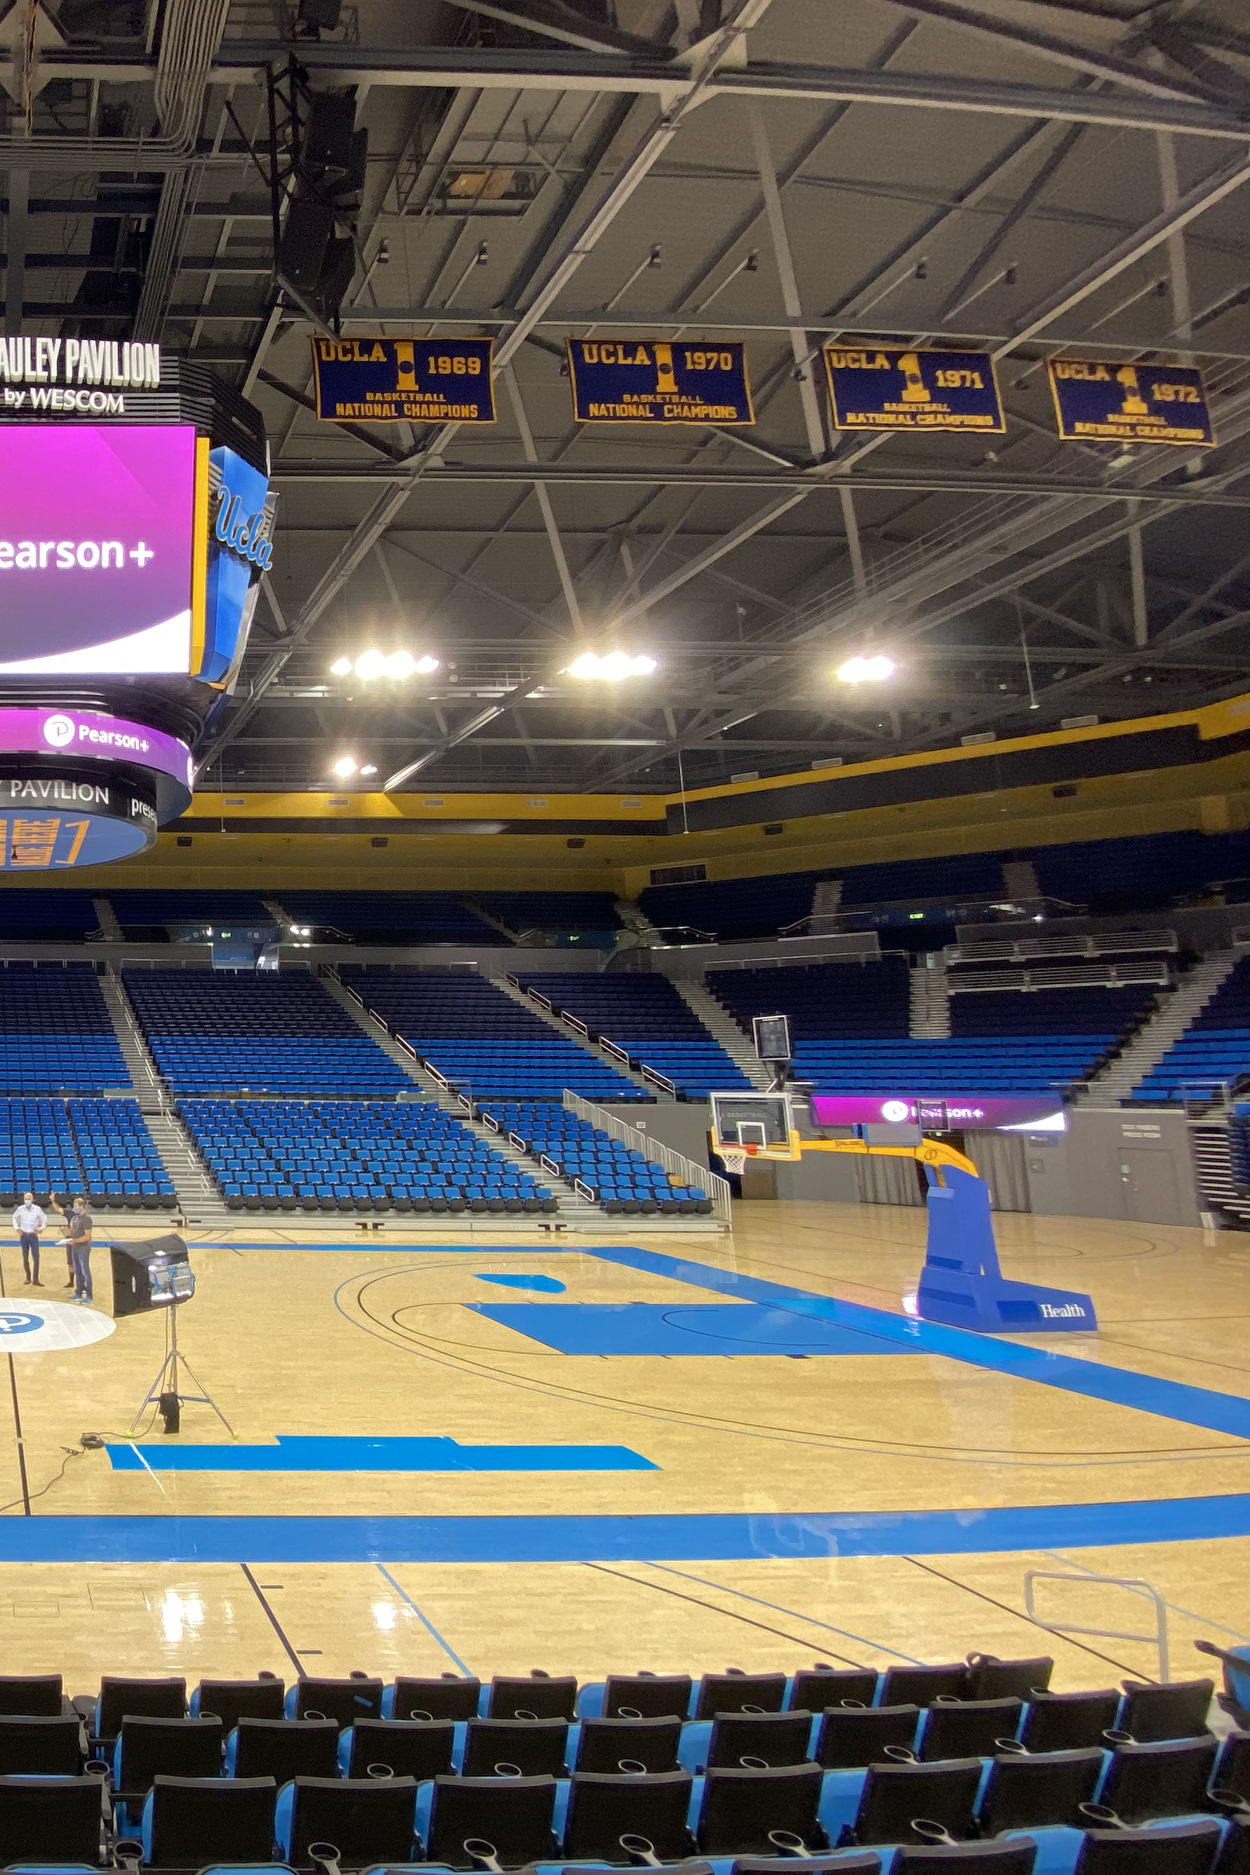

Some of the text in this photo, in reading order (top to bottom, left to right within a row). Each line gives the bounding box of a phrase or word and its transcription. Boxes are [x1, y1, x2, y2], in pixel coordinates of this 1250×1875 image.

[65, 339, 160, 388] PAVILION
[320, 342, 387, 362] UCLA
[428, 356, 481, 375] 1969
[582, 344, 651, 365] UCLA
[685, 352, 733, 371] 1970
[831, 352, 891, 370] UCLA
[935, 370, 984, 389] 1971
[1055, 363, 1110, 381] UCLA
[1151, 384, 1200, 403] 1972
[4, 387, 26, 405] by
[30, 388, 125, 413] WESCOM
[366, 392, 446, 402] BASKETBALL
[622, 394, 703, 404] BASKETBALL
[883, 402, 951, 412] BASKETBALL
[335, 403, 478, 418] NATIONAL CHAMPIONS
[588, 404, 737, 419] NATIONAL CHAMPIONS
[846, 412, 994, 426] NATIONAL CHAMPIONS
[78, 724, 150, 753] Pearson+
[10, 780, 110, 805] PAVILION
[1040, 1303, 1086, 1318] Health
